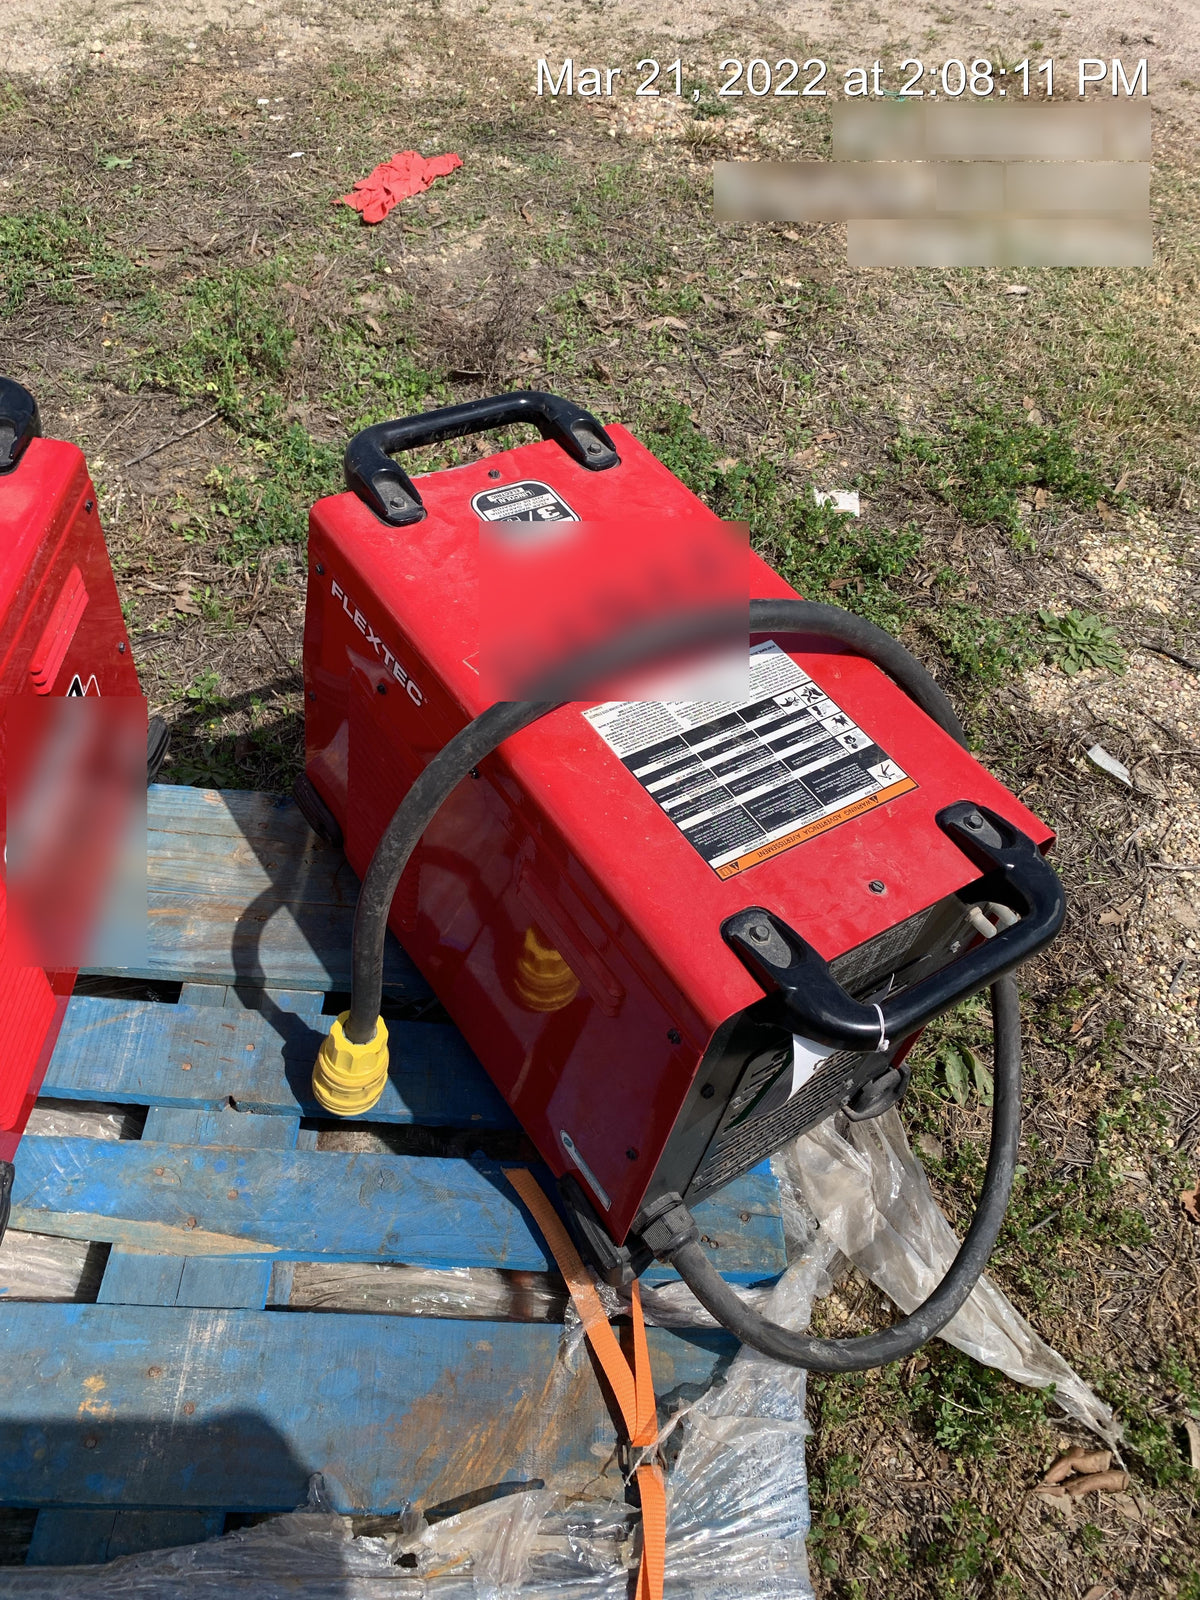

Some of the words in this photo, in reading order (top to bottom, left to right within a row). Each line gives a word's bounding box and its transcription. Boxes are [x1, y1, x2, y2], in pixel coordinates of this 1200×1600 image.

[331, 580, 423, 707] FLEXTEC
[843, 800, 872, 816] WARNING
[803, 815, 842, 835] ADVERTENCIA
[758, 833, 801, 857] AVERTISSEMENT
